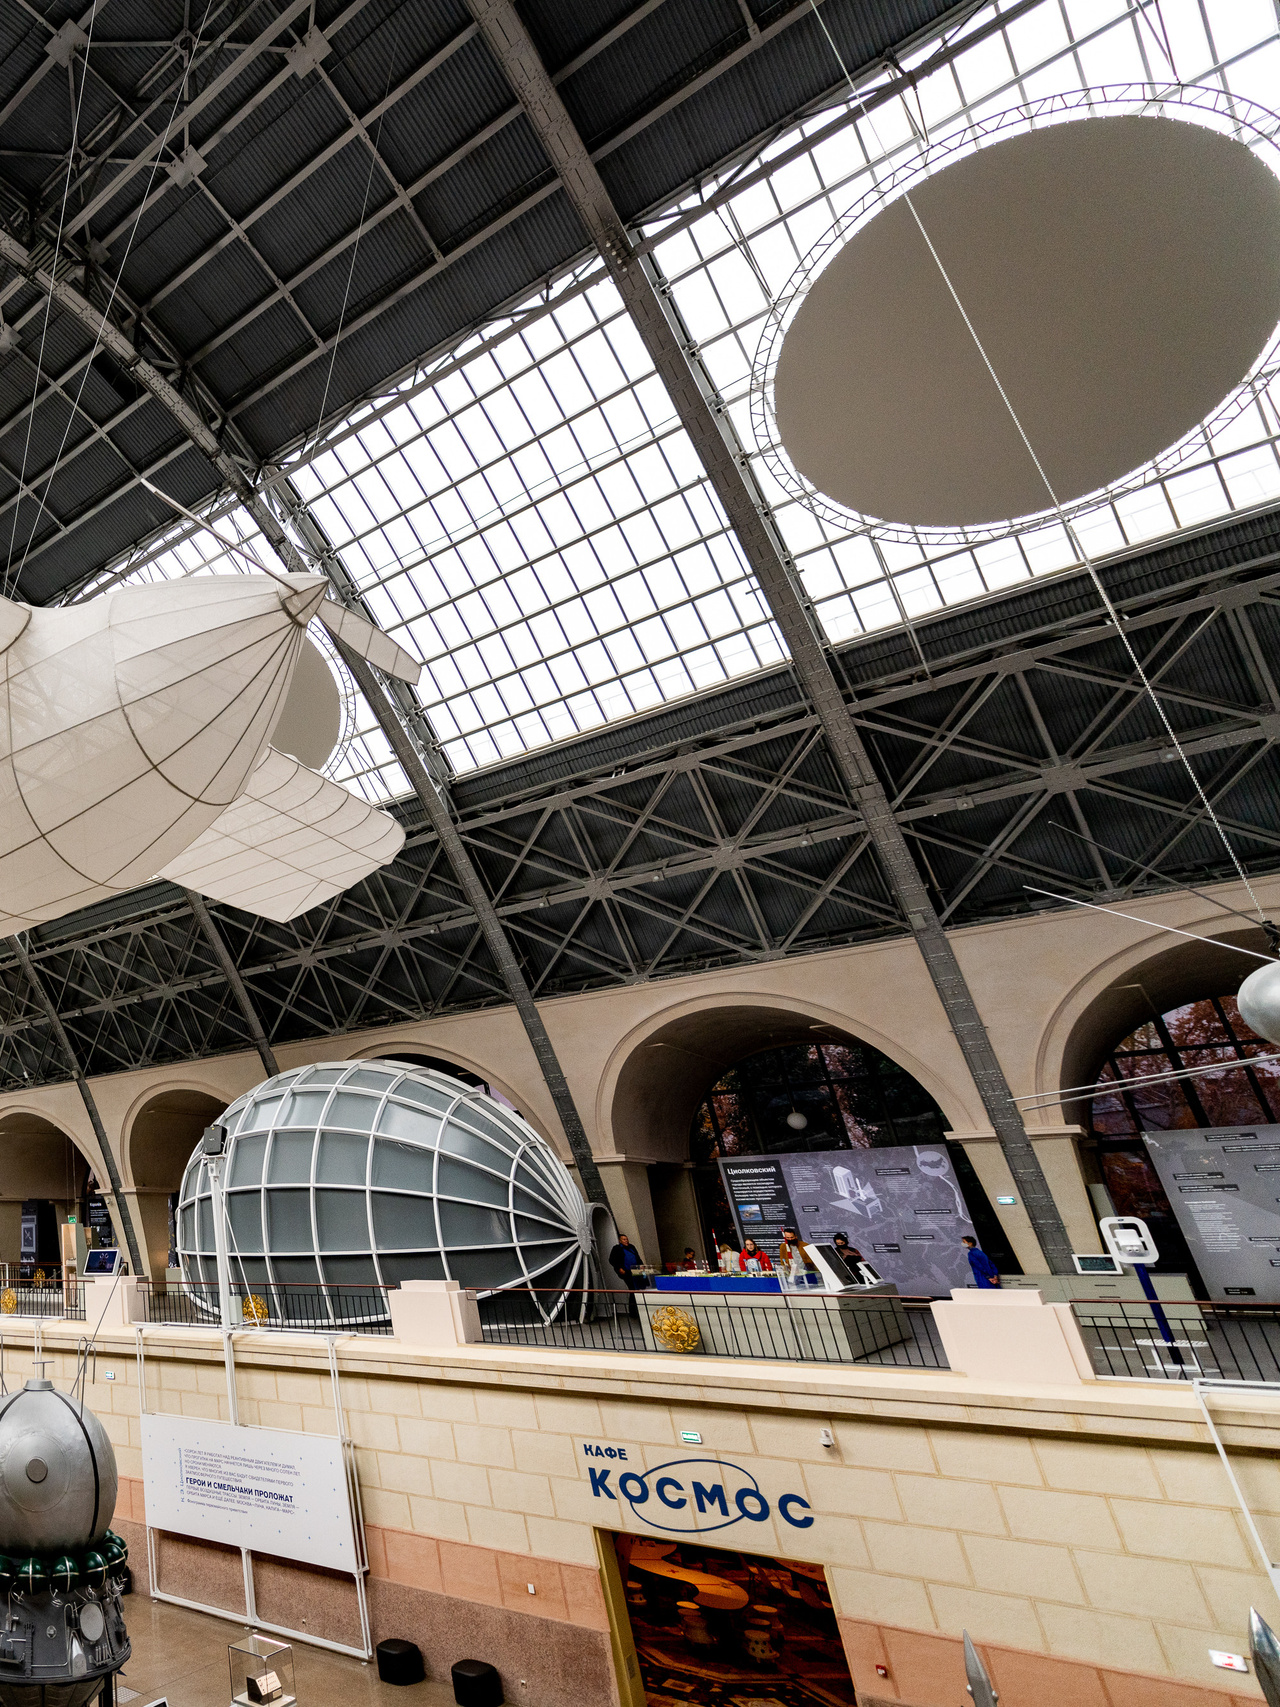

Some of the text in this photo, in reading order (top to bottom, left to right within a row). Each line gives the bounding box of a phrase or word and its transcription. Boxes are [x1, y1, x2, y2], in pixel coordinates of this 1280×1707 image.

[727, 1166, 776, 1175] Циолковский
[583, 1444, 628, 1460] КАФЕ
[186, 1477, 206, 1487] ГЕРОИ
[213, 1482, 254, 1496] СМЕЛЬЧАКИ
[254, 1489, 294, 1503] ПРОЛОЖАТ
[588, 1467, 815, 1528] КОСМОС
